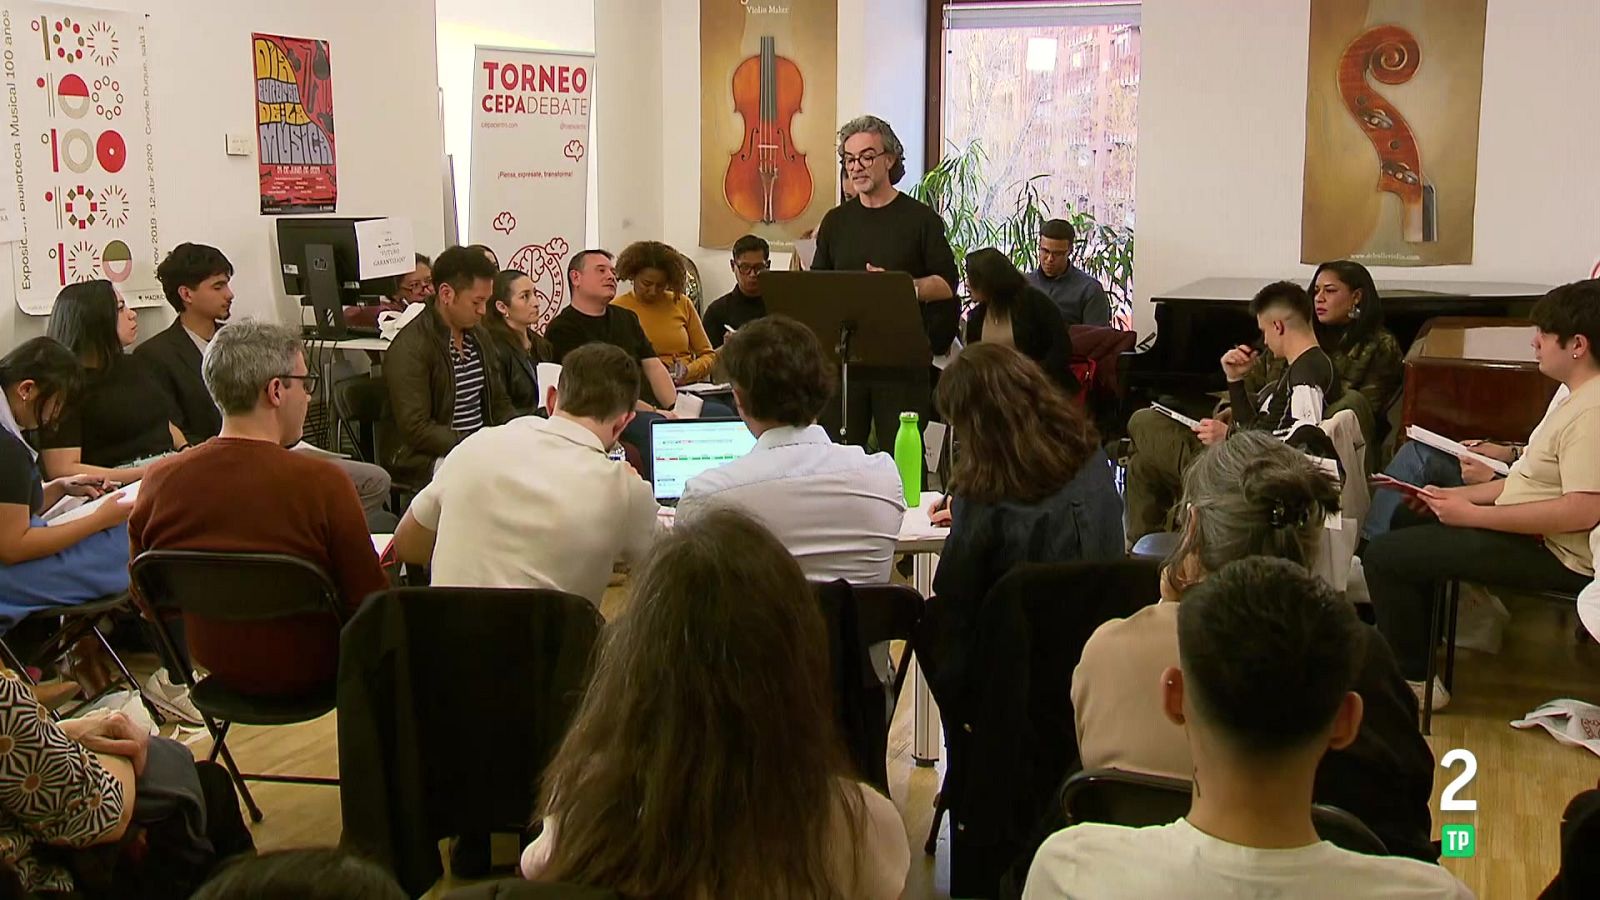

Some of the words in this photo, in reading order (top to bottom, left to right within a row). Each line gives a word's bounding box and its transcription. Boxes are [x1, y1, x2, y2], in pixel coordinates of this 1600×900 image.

[4, 50, 15, 78] 100
[483, 61, 587, 93] TORNEO
[8, 83, 20, 137] Musical
[544, 257, 562, 322] DISTRITO
